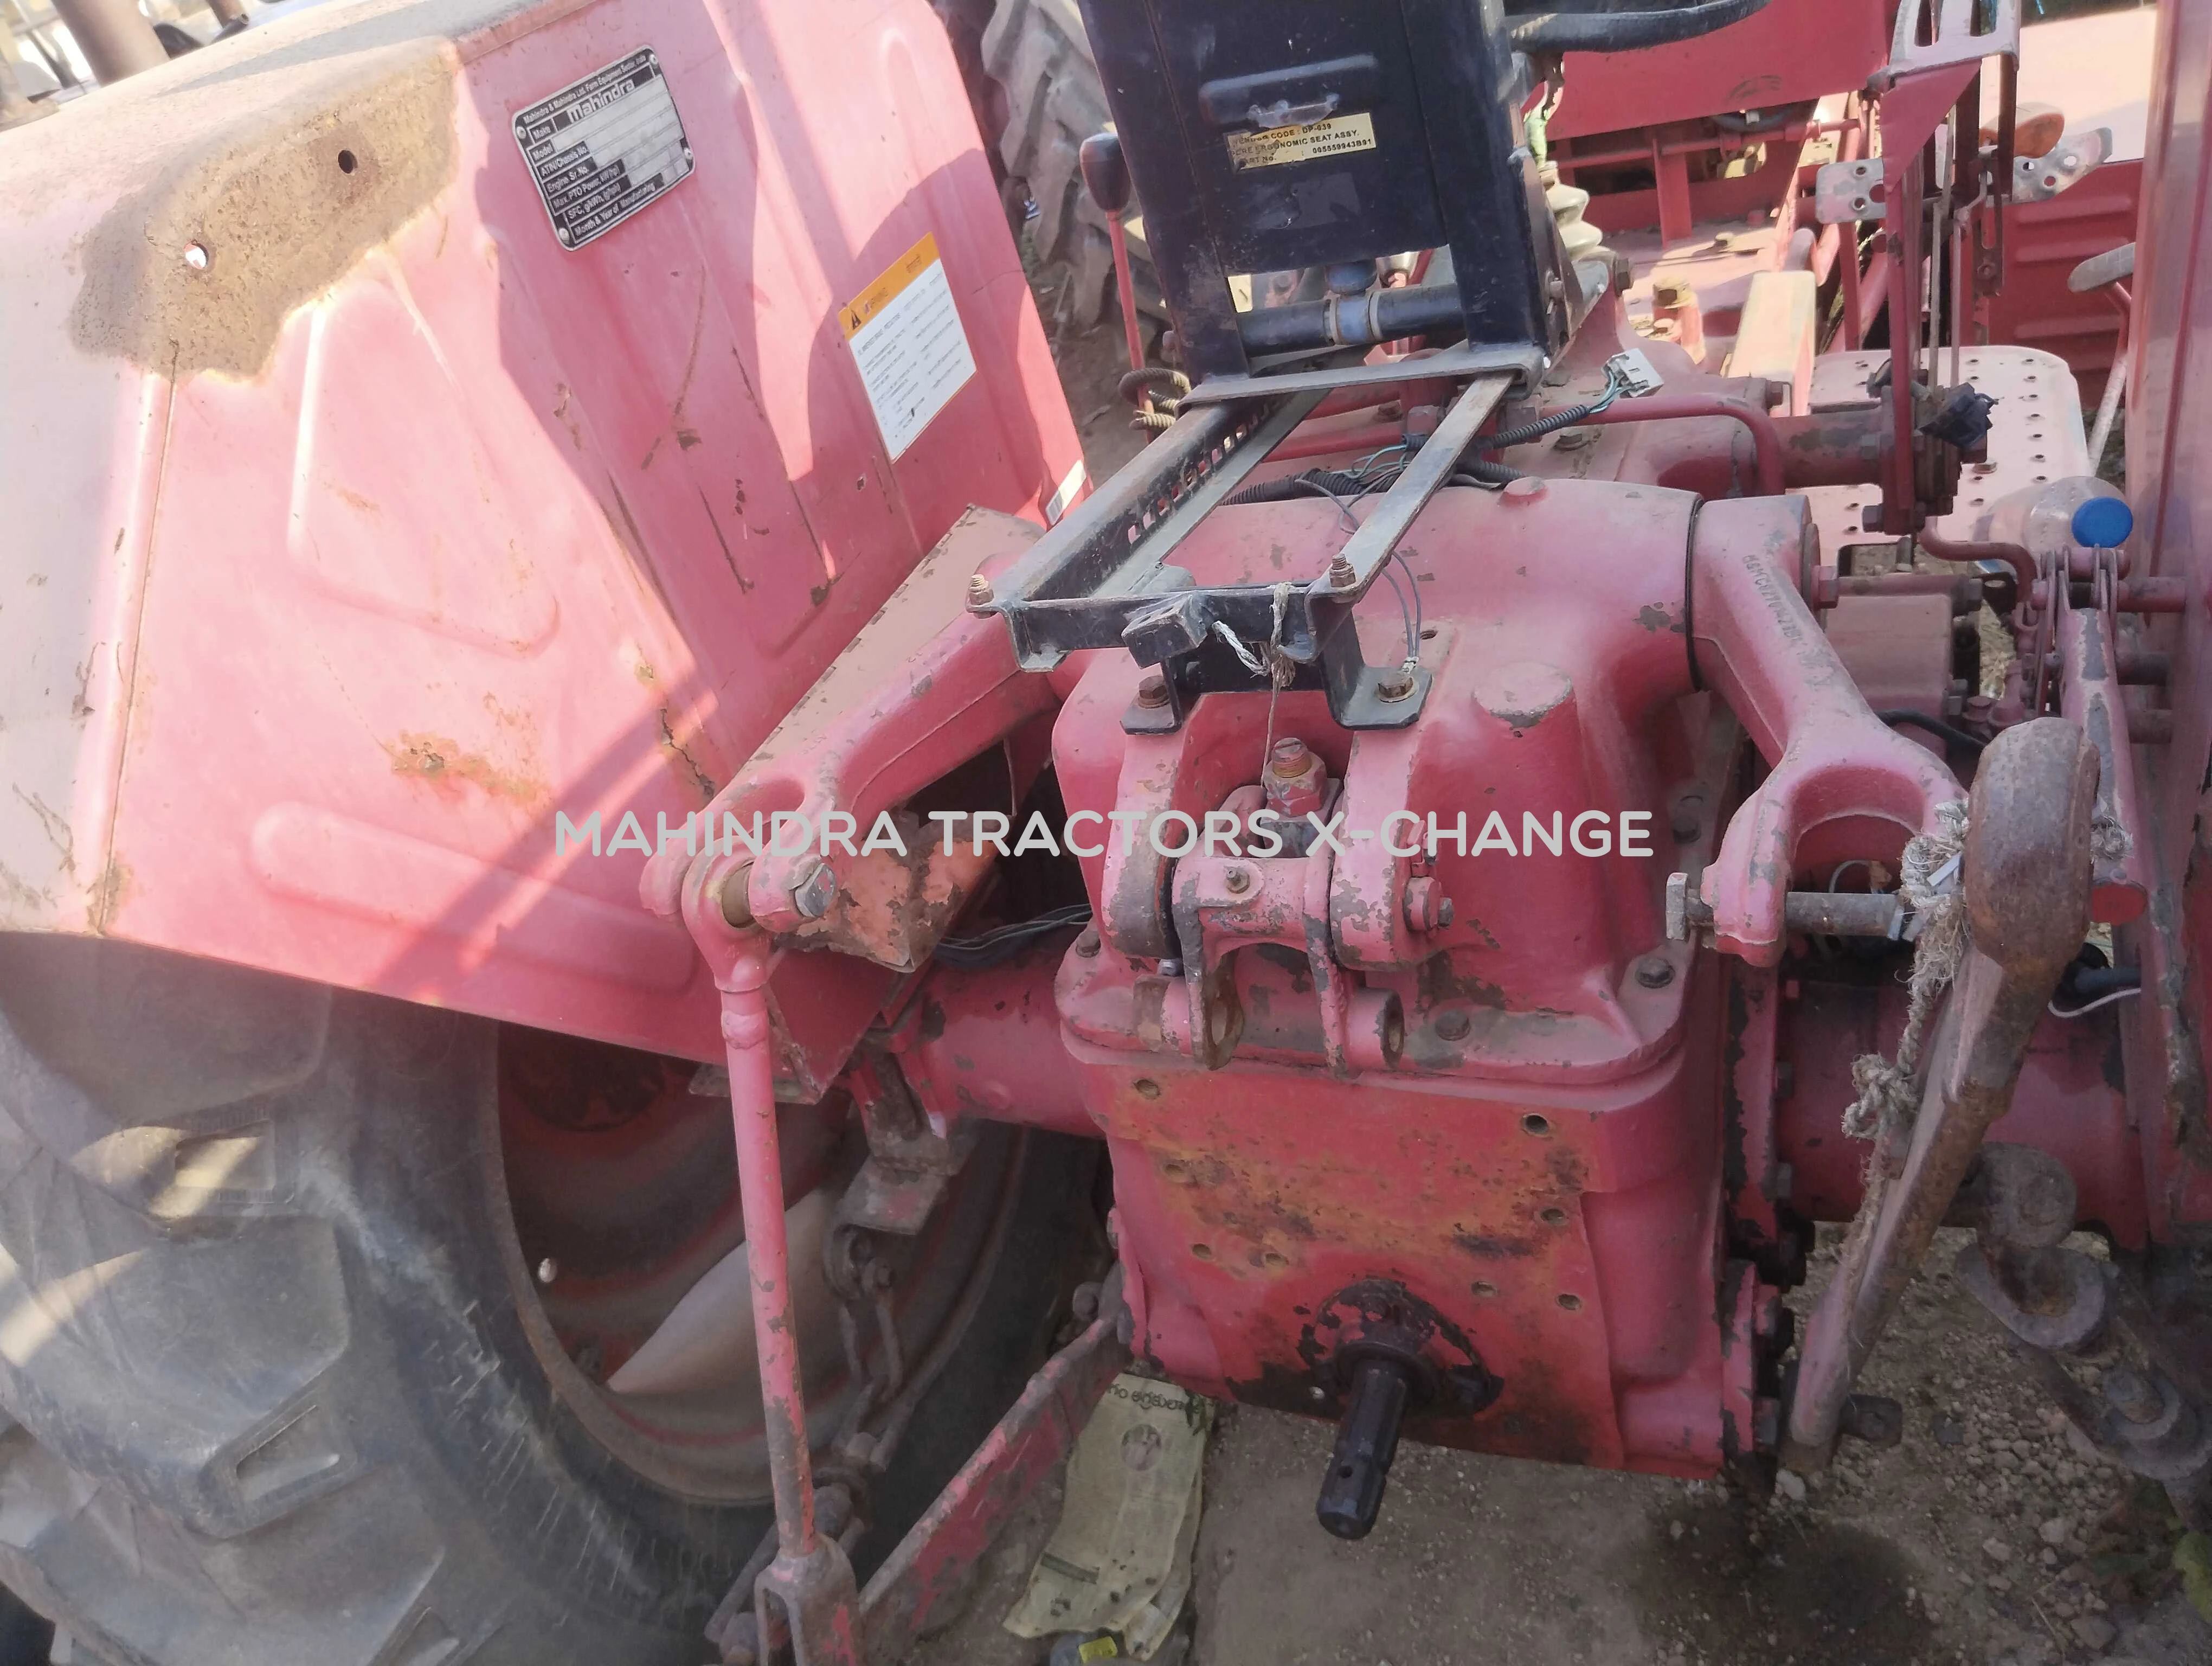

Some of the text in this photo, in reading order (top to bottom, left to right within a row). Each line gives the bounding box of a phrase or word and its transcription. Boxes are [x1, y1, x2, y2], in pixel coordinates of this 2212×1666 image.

[523, 105, 549, 123] Mahindra
[533, 126, 551, 139] Make
[1271, 130, 1295, 139] CODE
[1310, 134, 1332, 143] SEAT
[532, 144, 554, 160] Model
[576, 146, 589, 157] No.
[547, 176, 569, 193] Engine
